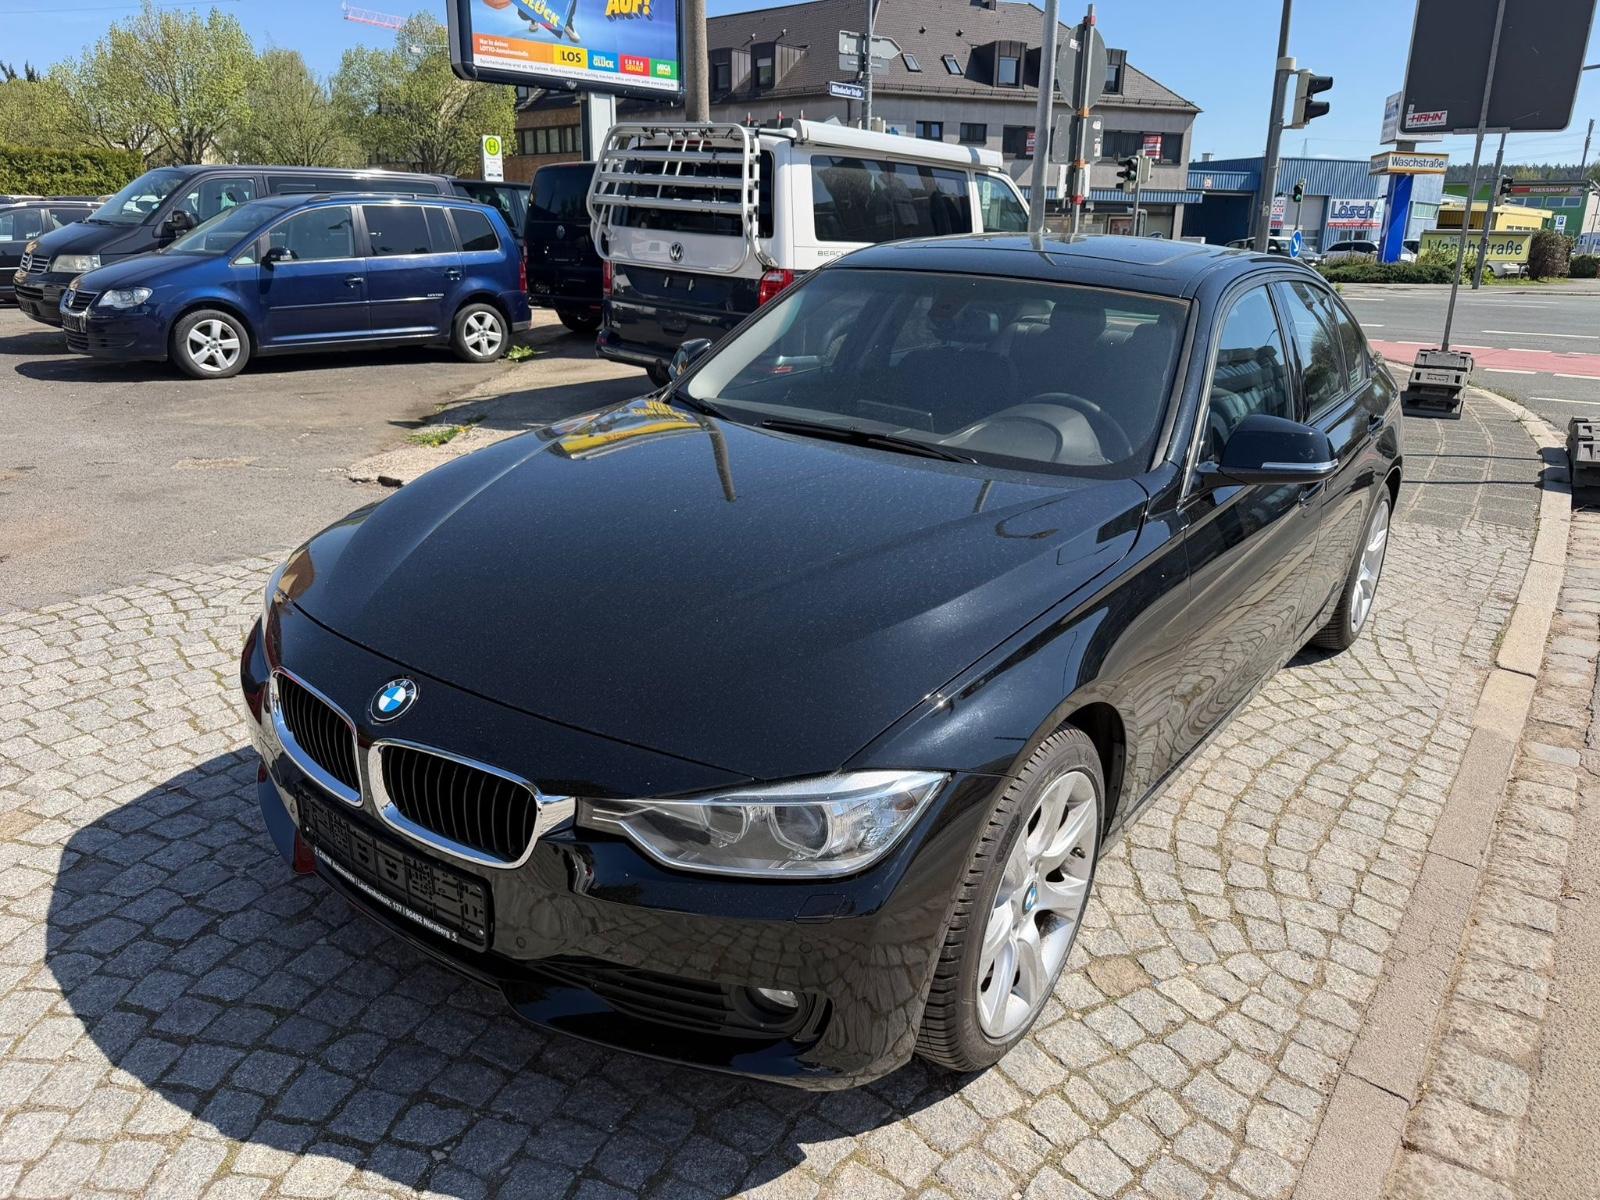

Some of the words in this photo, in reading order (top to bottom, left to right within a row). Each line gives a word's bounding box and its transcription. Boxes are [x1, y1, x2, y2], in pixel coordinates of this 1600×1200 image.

[562, 51, 582, 63] LOS
[1409, 112, 1446, 123] HAHN
[1391, 156, 1444, 168] Waschstraße
[1330, 200, 1374, 219] Lösch
[405, 908, 423, 924] 90482
[423, 918, 450, 939] Nürnberg
